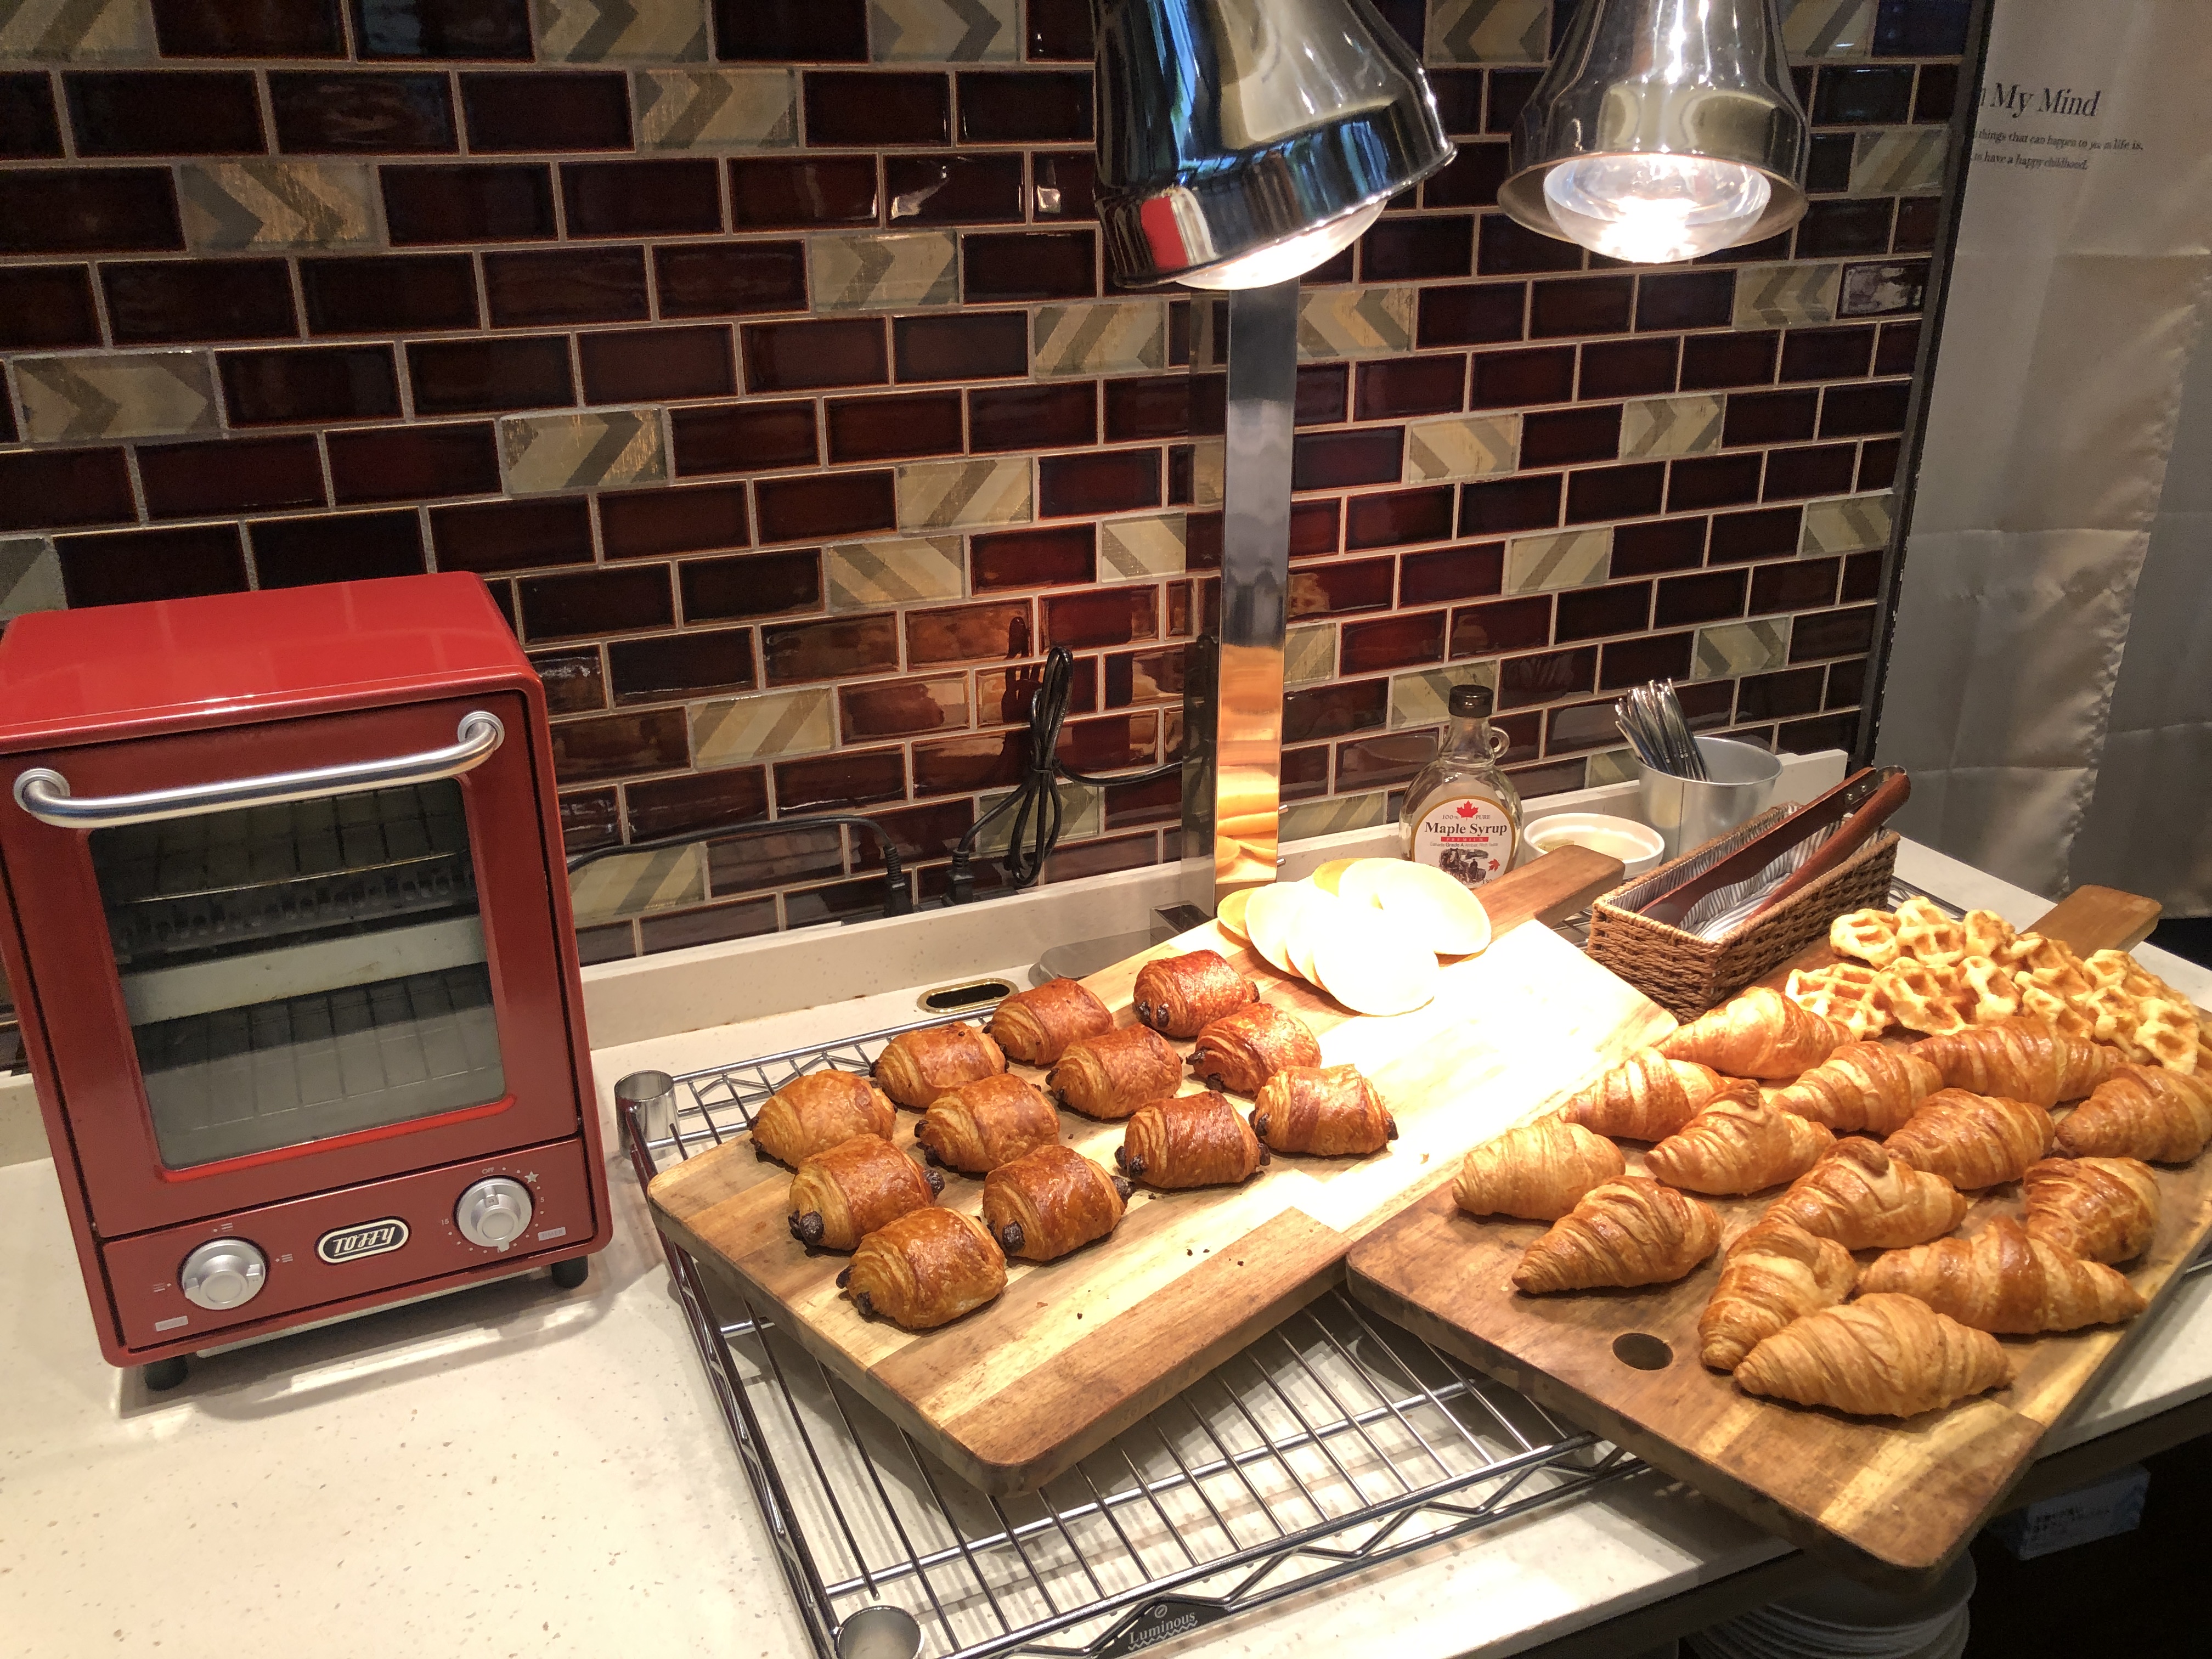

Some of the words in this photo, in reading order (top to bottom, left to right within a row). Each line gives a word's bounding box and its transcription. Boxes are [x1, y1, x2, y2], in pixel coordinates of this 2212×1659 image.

[1990, 82, 2033, 118] My
[2038, 88, 2101, 117] Mind
[2008, 132, 2028, 143] that
[2030, 136, 2045, 144] can
[2047, 134, 2076, 149] happen
[2113, 138, 2130, 150] life
[1984, 151, 2006, 162] have
[2015, 154, 2044, 169] happy
[1424, 821, 1466, 836] Maple
[1469, 823, 1508, 837] Syrup
[1129, 1612, 1195, 1644] Luminous
